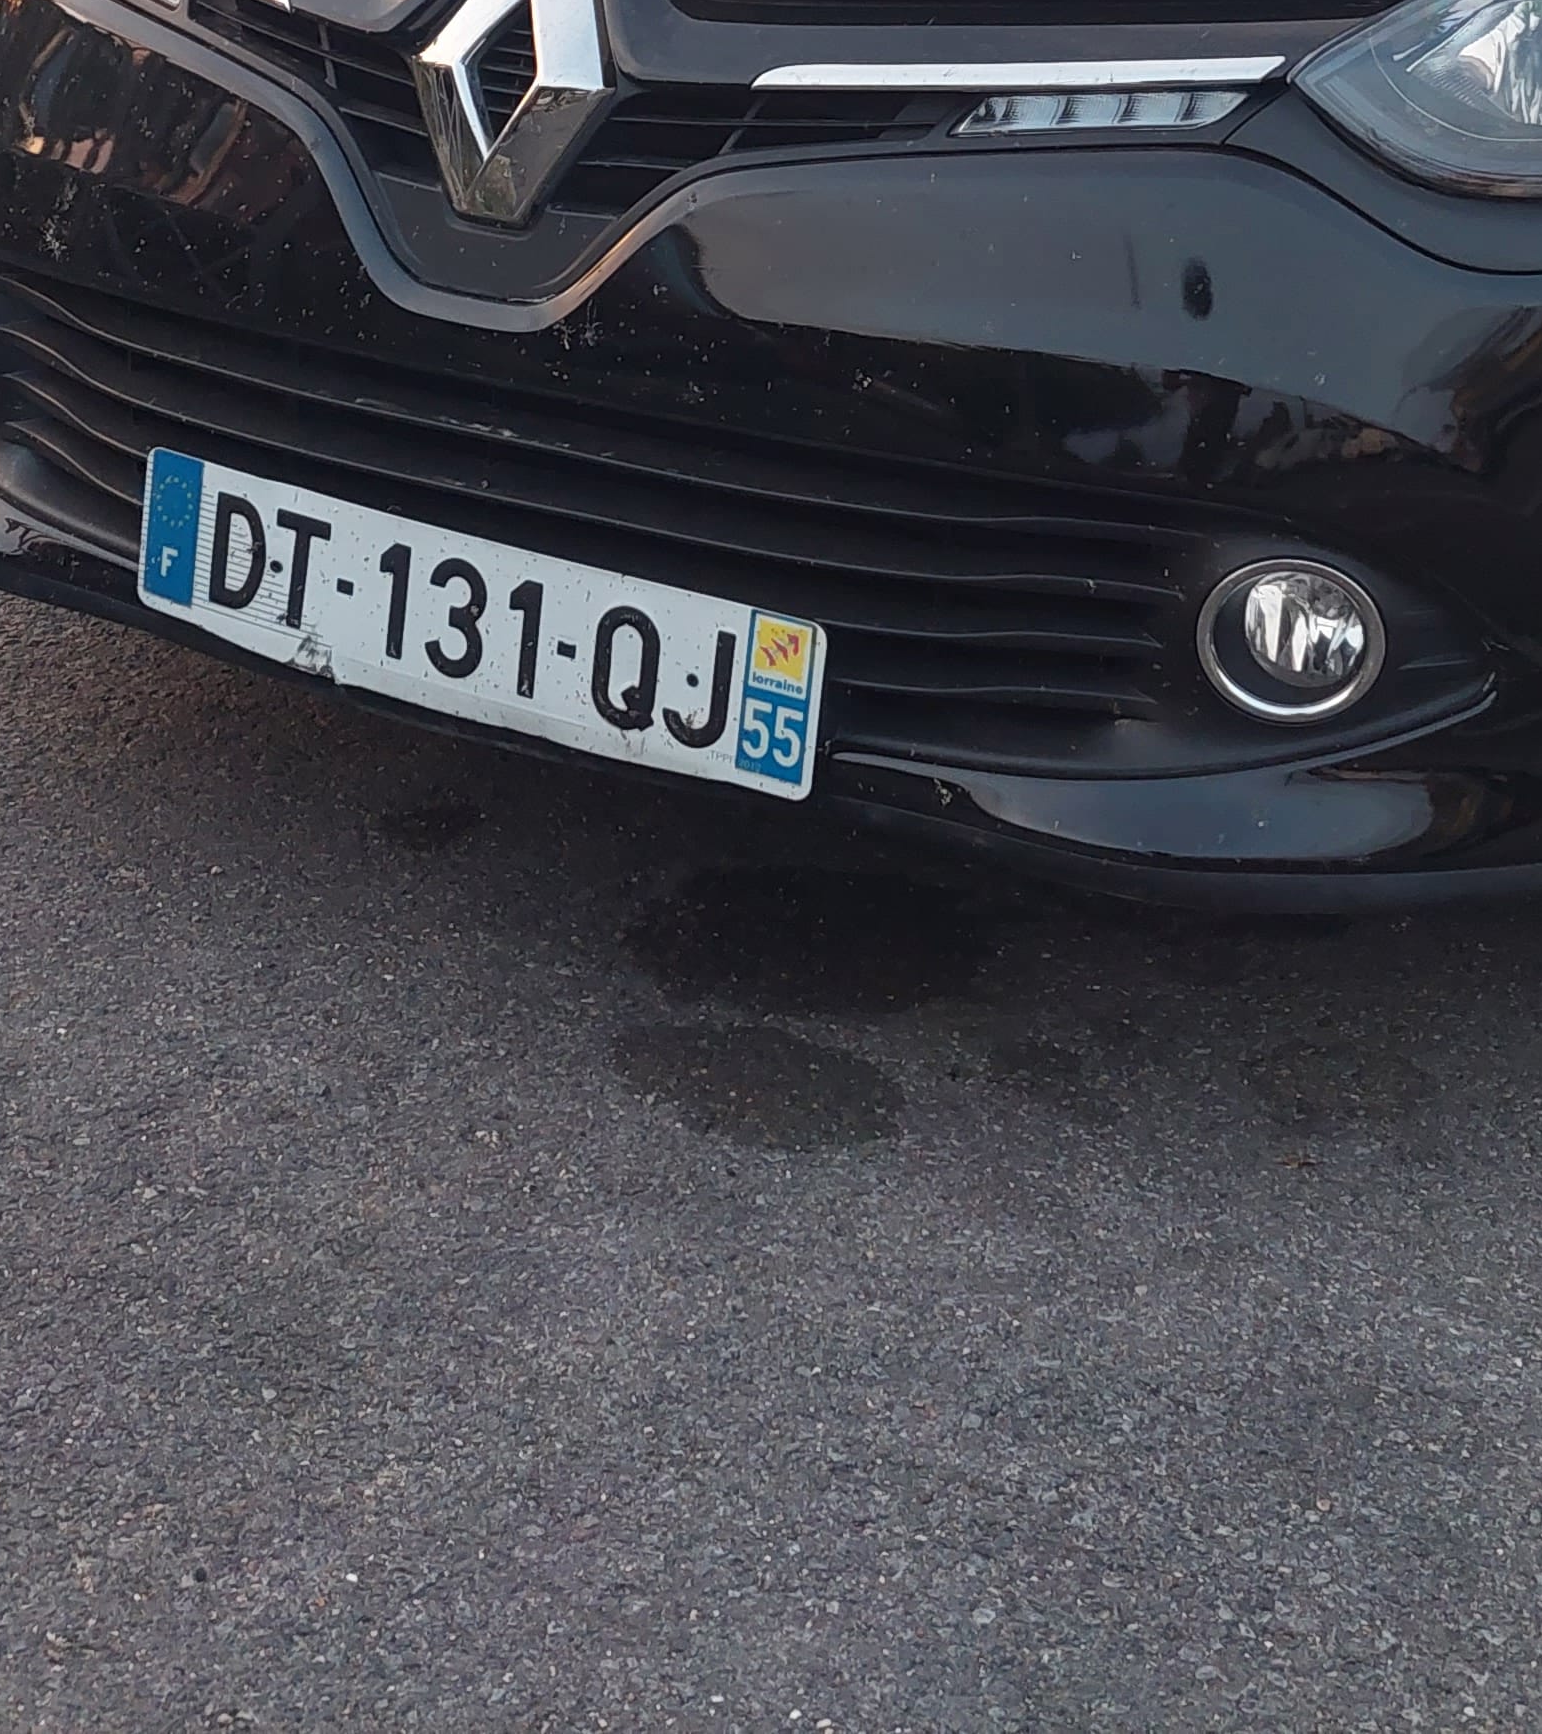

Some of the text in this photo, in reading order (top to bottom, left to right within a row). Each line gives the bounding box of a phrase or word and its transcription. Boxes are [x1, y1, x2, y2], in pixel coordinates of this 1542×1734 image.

[160, 546, 178, 577] F
[209, 491, 736, 747] DT-131-QJ
[752, 671, 803, 694] lorraine
[742, 697, 804, 767] 55
